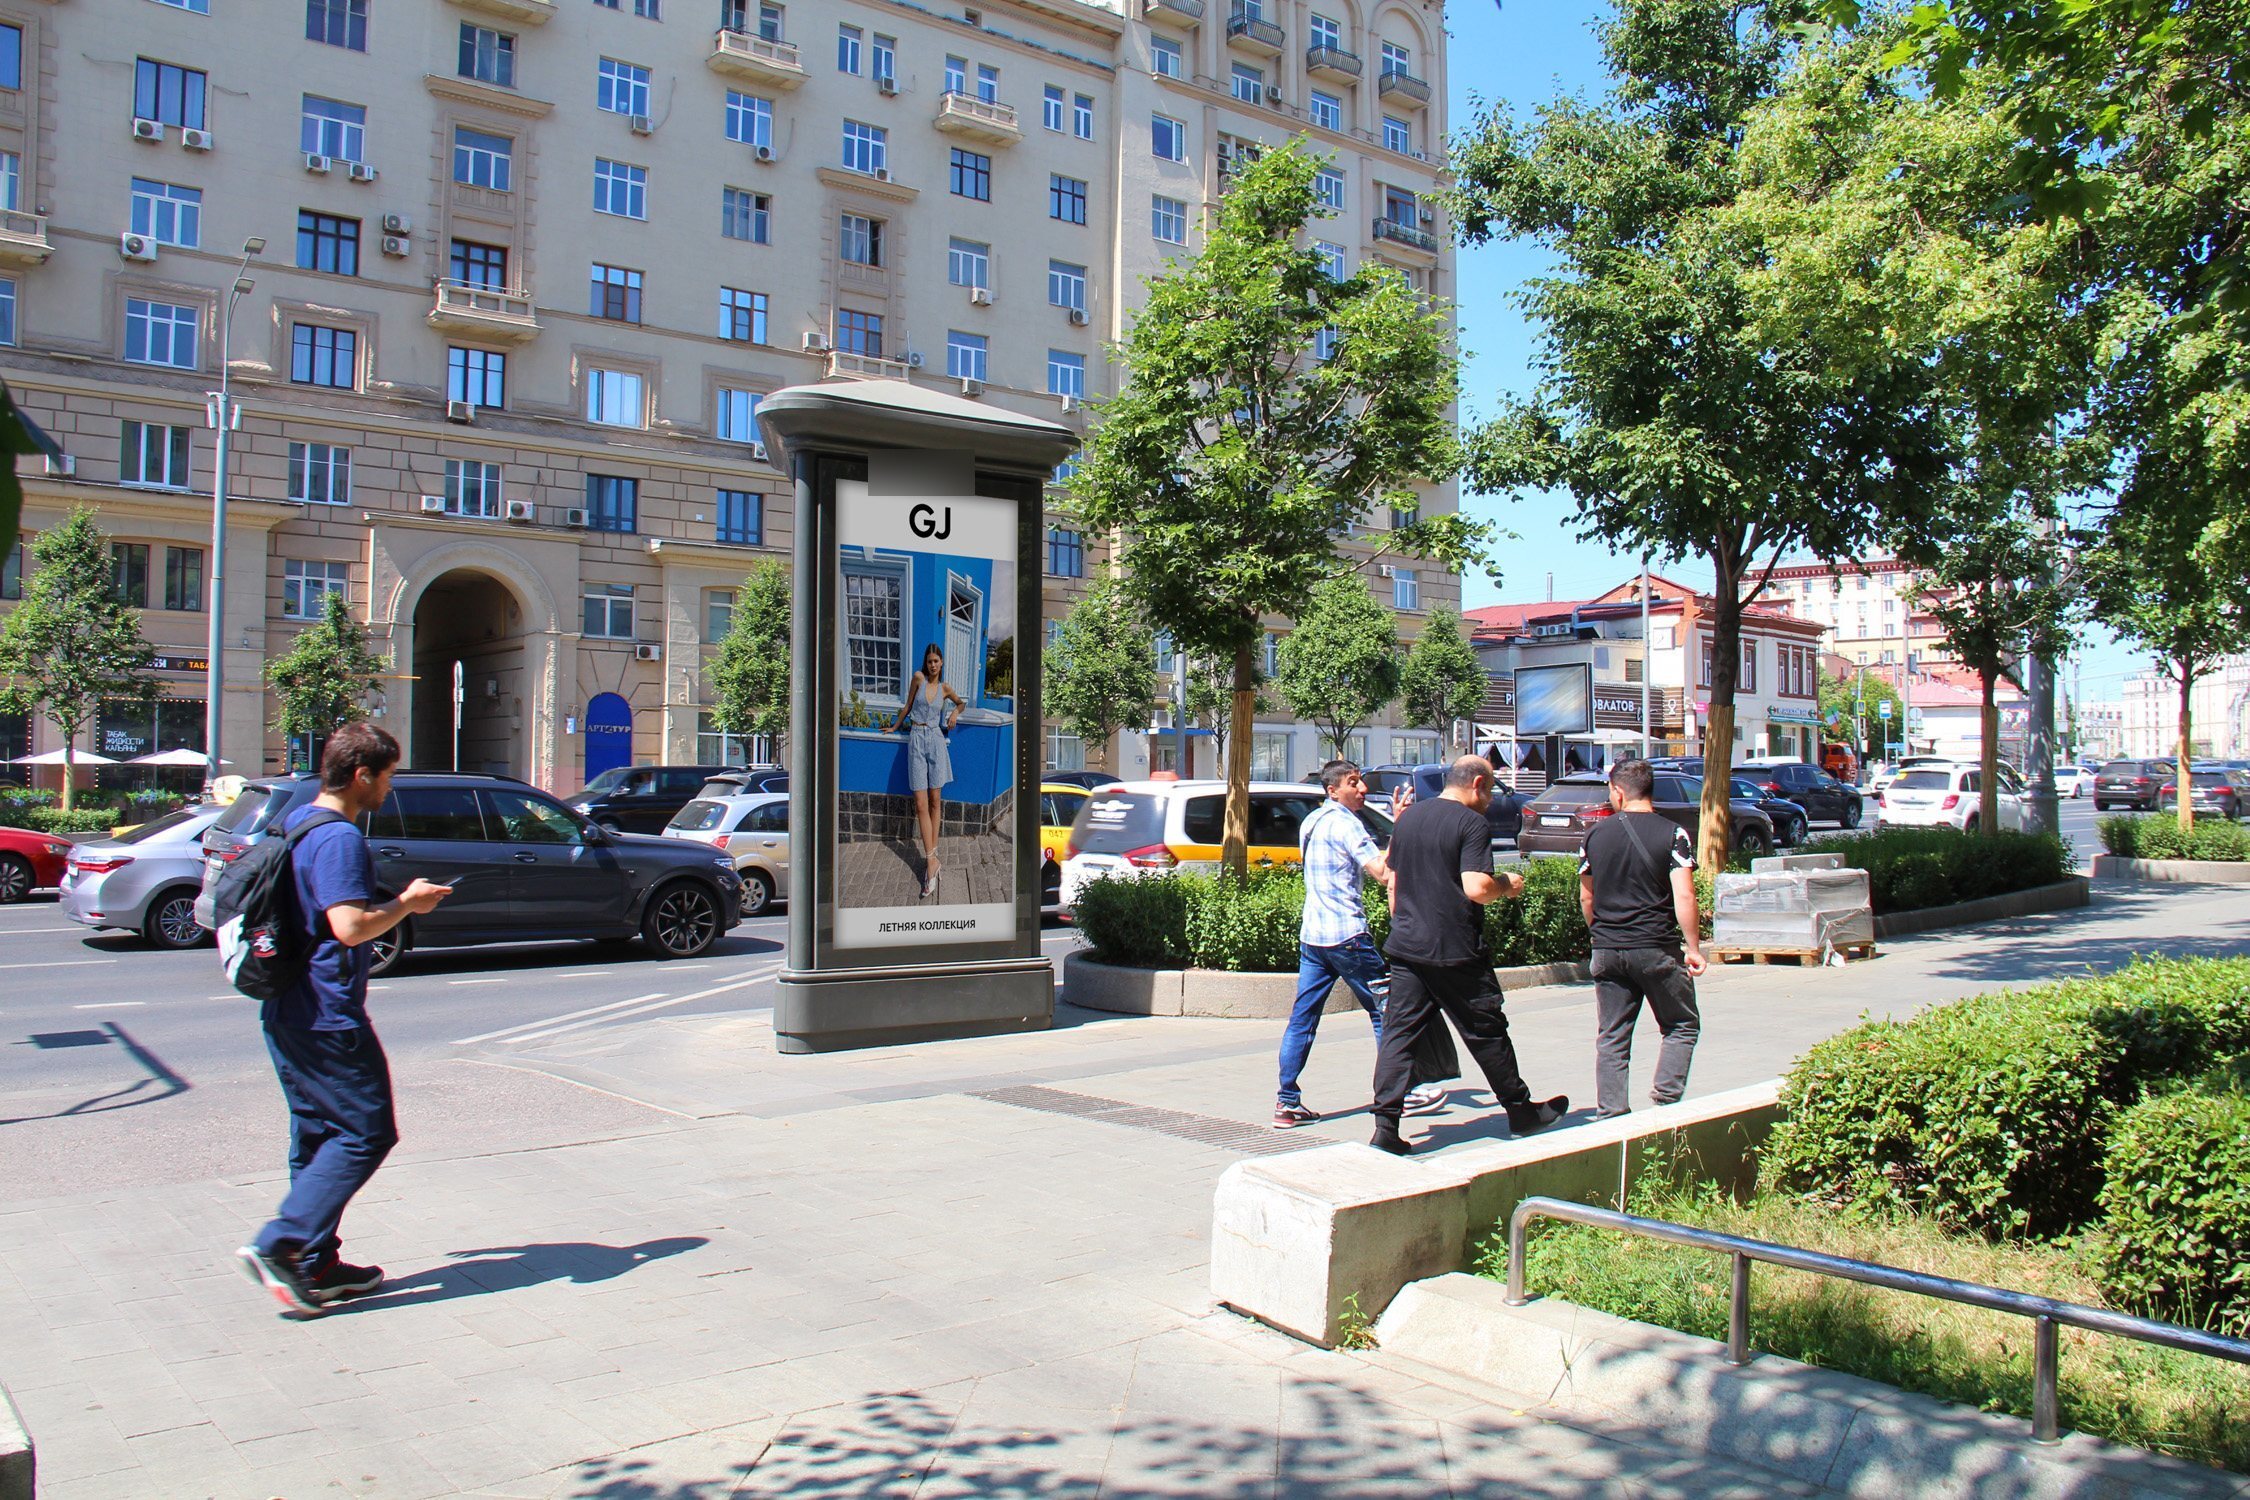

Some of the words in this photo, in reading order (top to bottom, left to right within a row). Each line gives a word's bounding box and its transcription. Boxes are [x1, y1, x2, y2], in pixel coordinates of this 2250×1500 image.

[909, 503, 951, 540] GJ
[106, 730, 127, 738] ТАБАК
[105, 737, 144, 745] ЖИДКОСТИ
[105, 744, 138, 752] КАЛЬЯНЫ
[879, 922, 916, 932] ЛЕТНЯЯ
[919, 919, 976, 930] КОЛЛЕКЦИЯ
